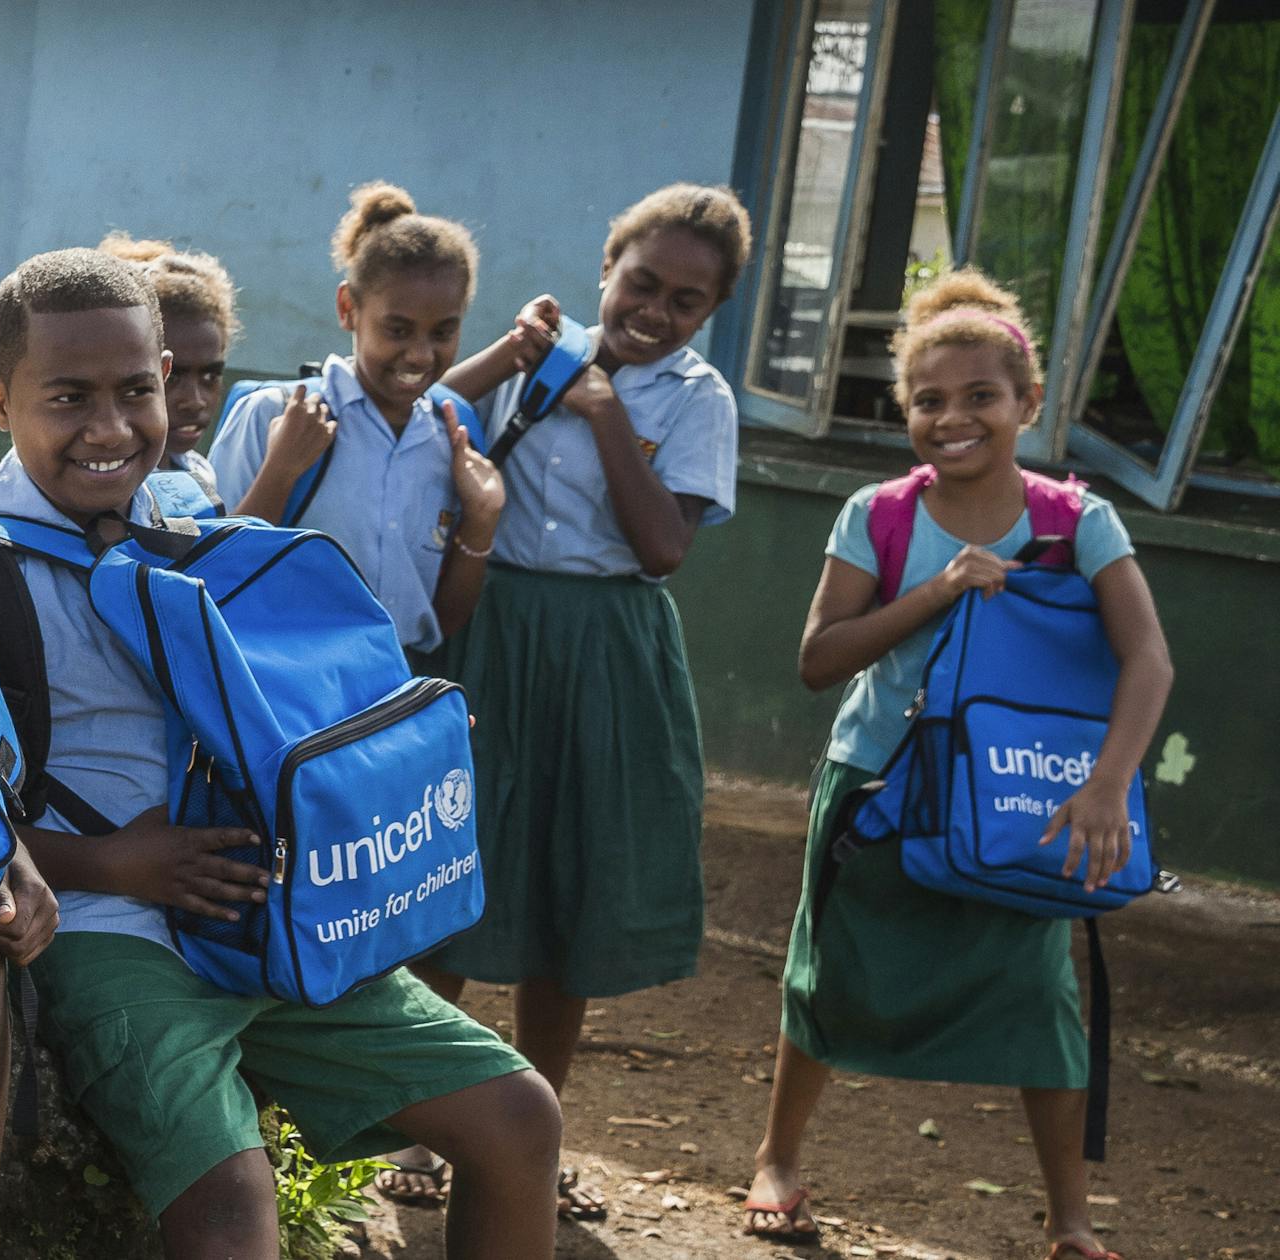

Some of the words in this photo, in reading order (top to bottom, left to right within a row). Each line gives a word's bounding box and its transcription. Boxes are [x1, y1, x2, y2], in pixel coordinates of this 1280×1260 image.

[989, 741, 1092, 786] unicef
[994, 793, 1042, 816] unite
[309, 784, 433, 887] unicef
[317, 908, 381, 943] unite
[385, 893, 413, 919] for
